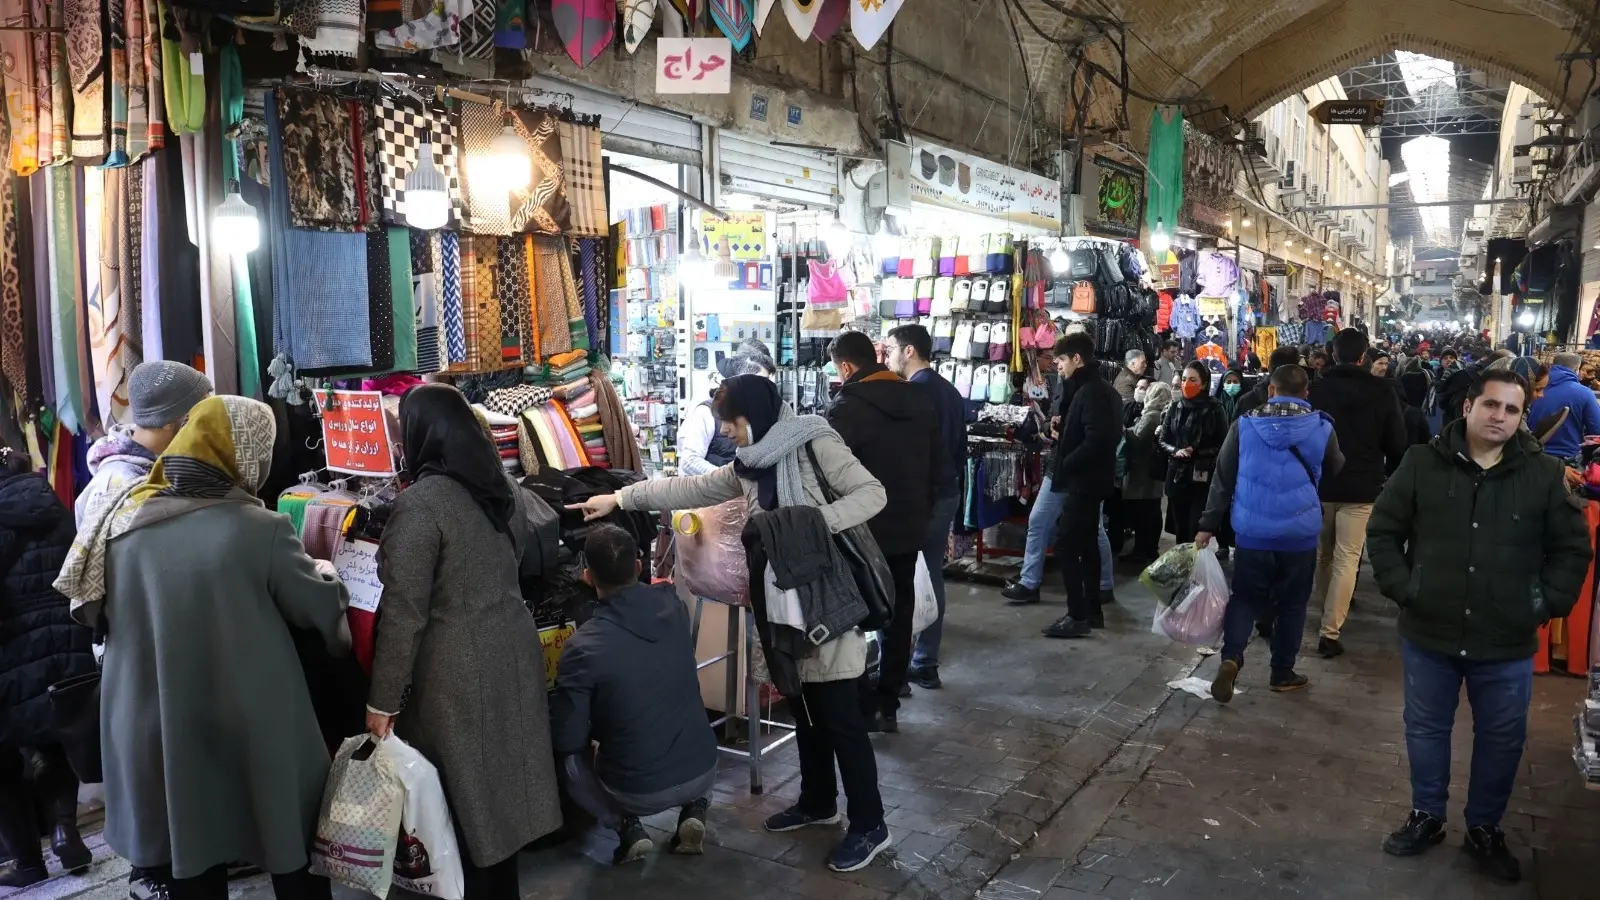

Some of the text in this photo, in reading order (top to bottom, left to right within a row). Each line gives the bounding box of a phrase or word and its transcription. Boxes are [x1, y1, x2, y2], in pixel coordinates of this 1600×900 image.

[663, 46, 727, 81] حراج
[348, 418, 359, 431] شال
[360, 420, 377, 433] انواع
[360, 441, 379, 455] ارزان
